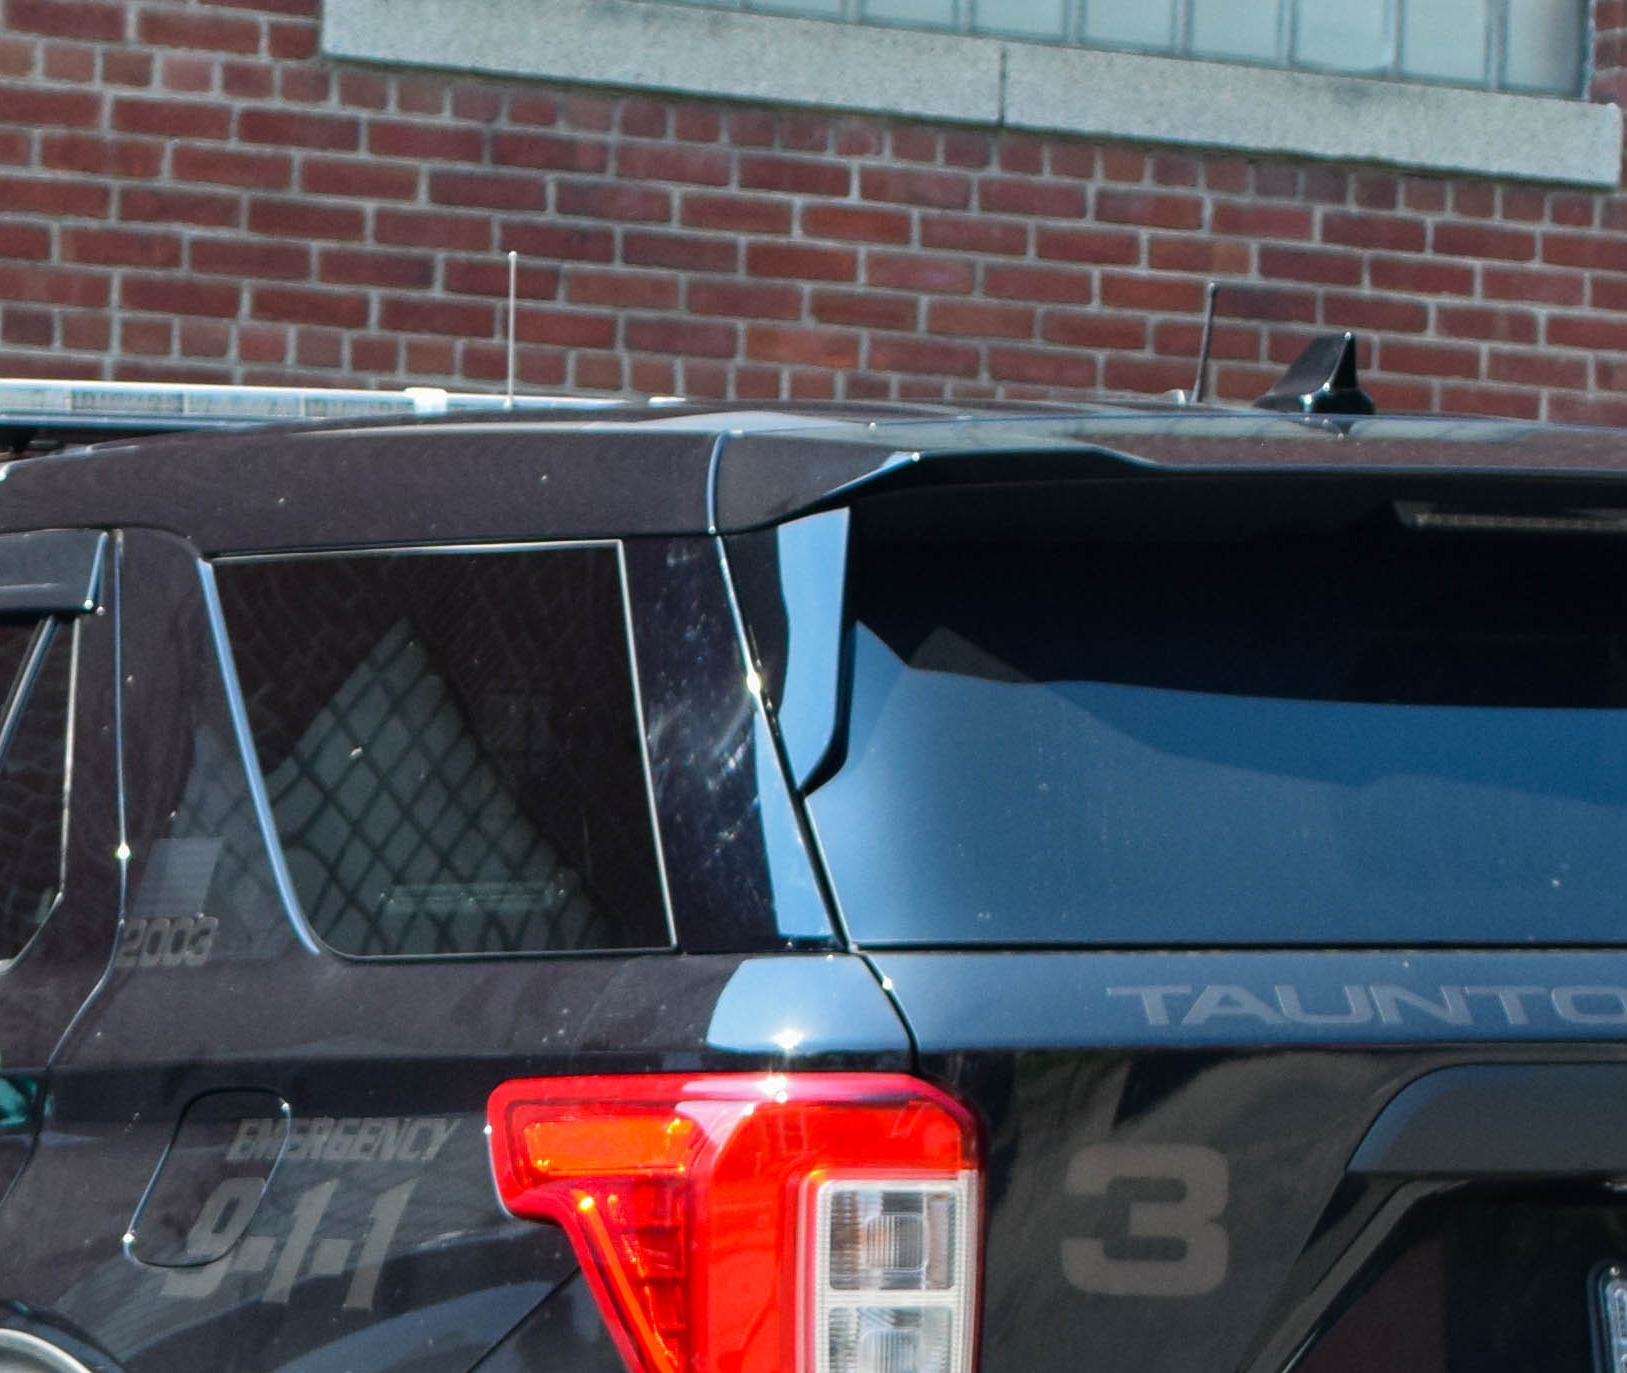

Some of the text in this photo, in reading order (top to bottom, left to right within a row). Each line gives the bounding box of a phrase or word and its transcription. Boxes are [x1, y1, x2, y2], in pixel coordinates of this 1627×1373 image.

[115, 916, 219, 968] 2003
[226, 1117, 466, 1161] EMERGENCY
[1061, 1141, 1230, 1297] 3
